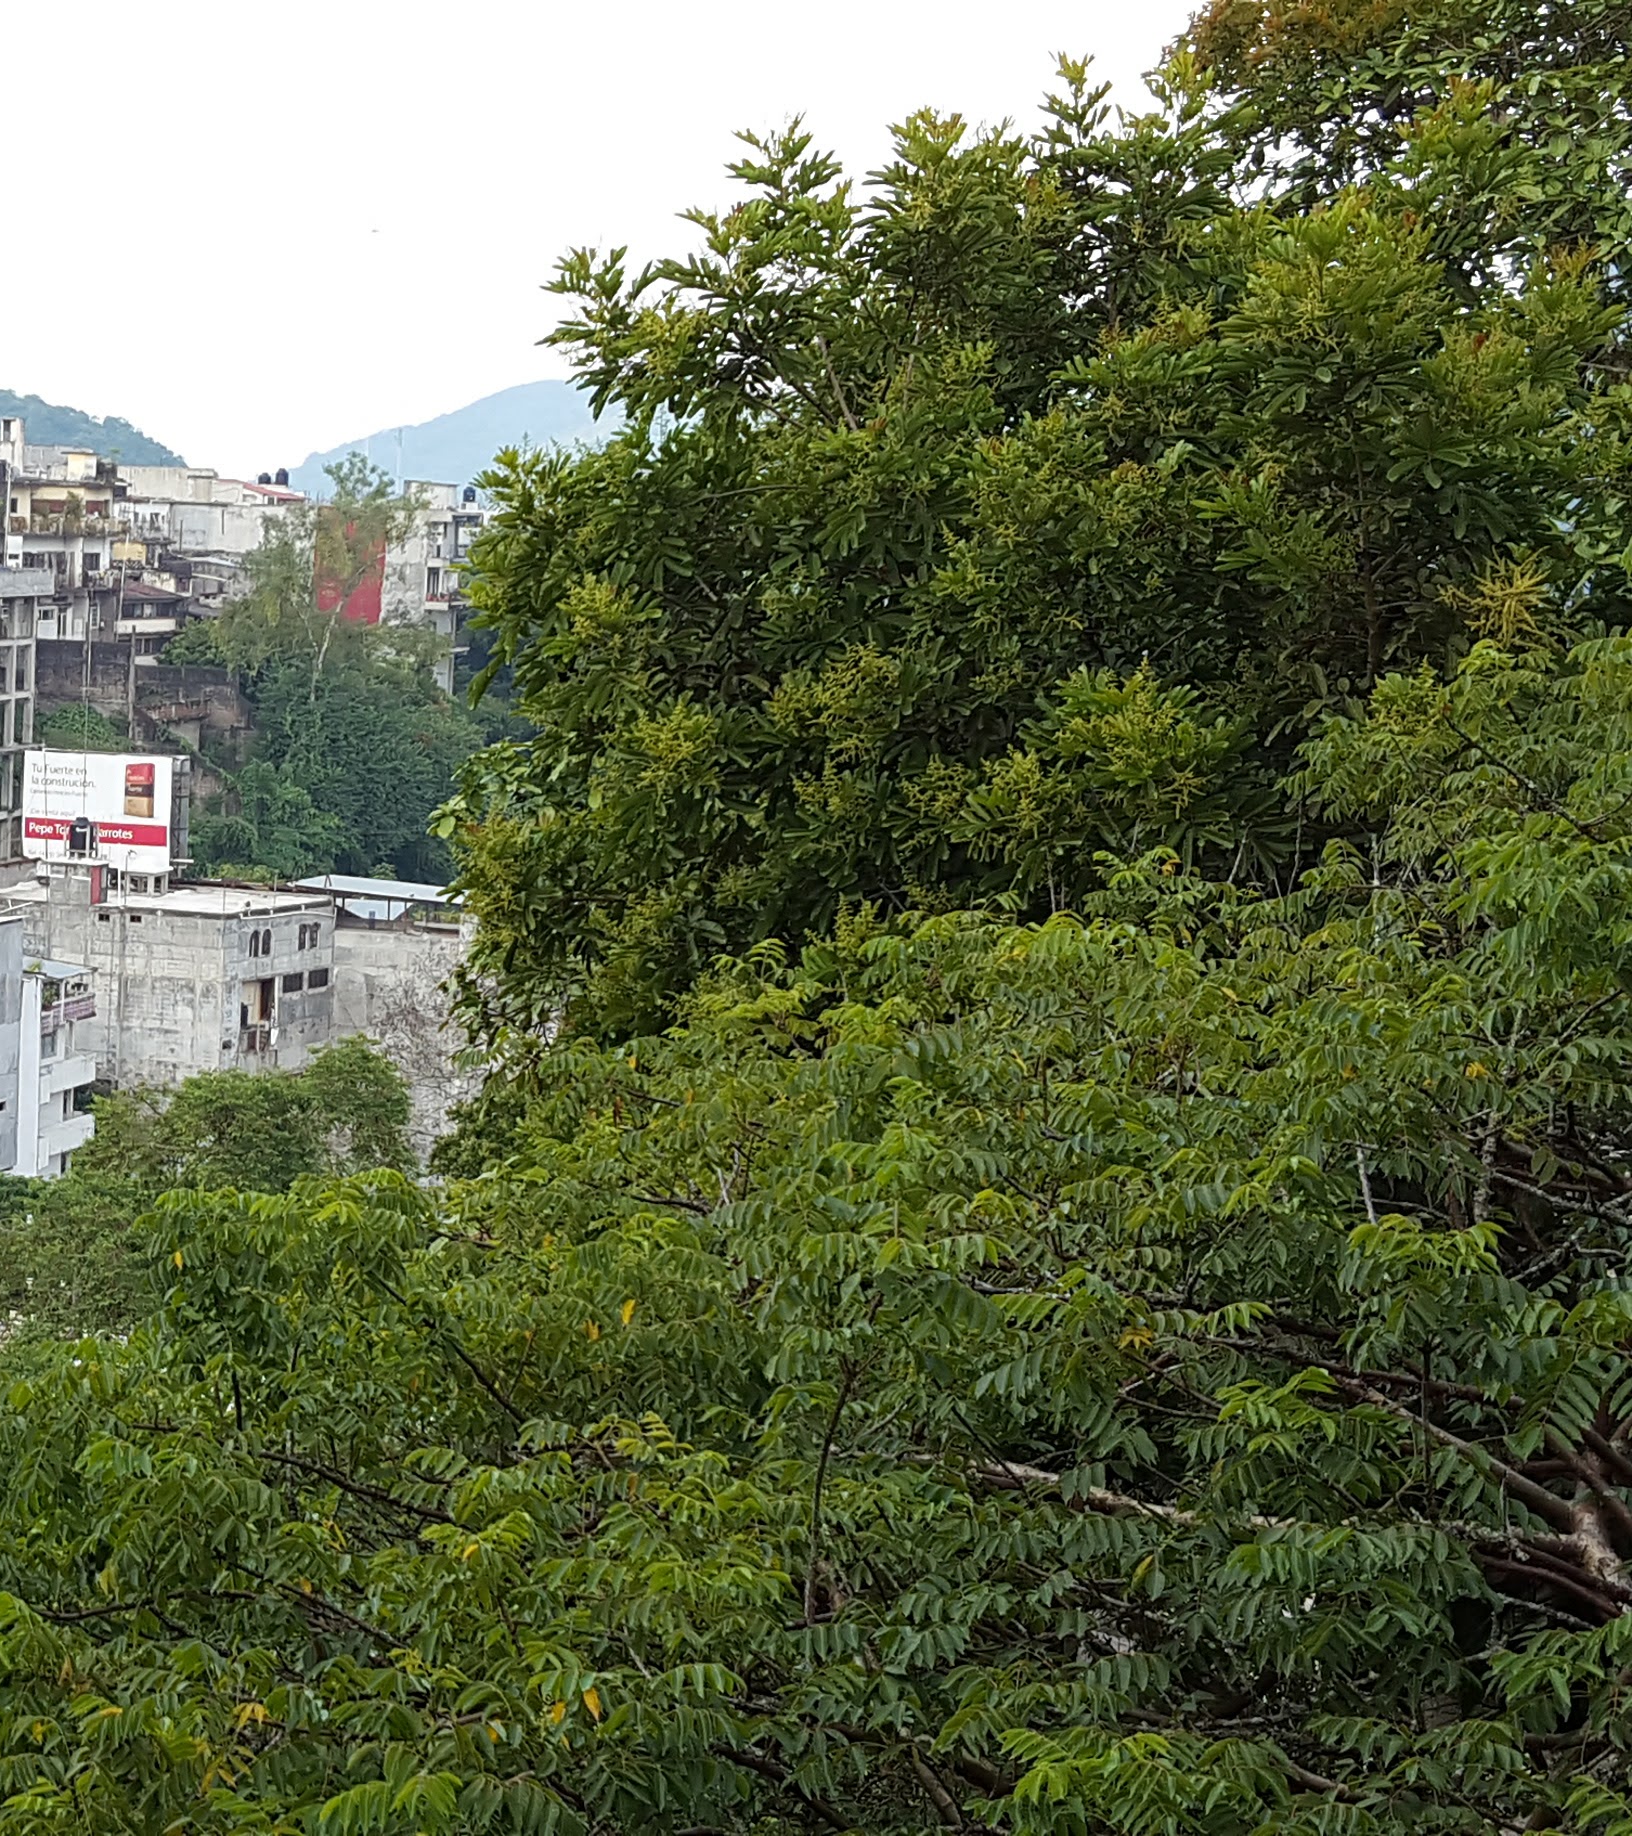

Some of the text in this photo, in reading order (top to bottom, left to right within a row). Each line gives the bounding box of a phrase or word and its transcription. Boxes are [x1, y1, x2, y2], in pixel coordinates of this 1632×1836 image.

[31, 762, 43, 773] Tu
[31, 775, 39, 785] la
[29, 821, 54, 836] Pepe
